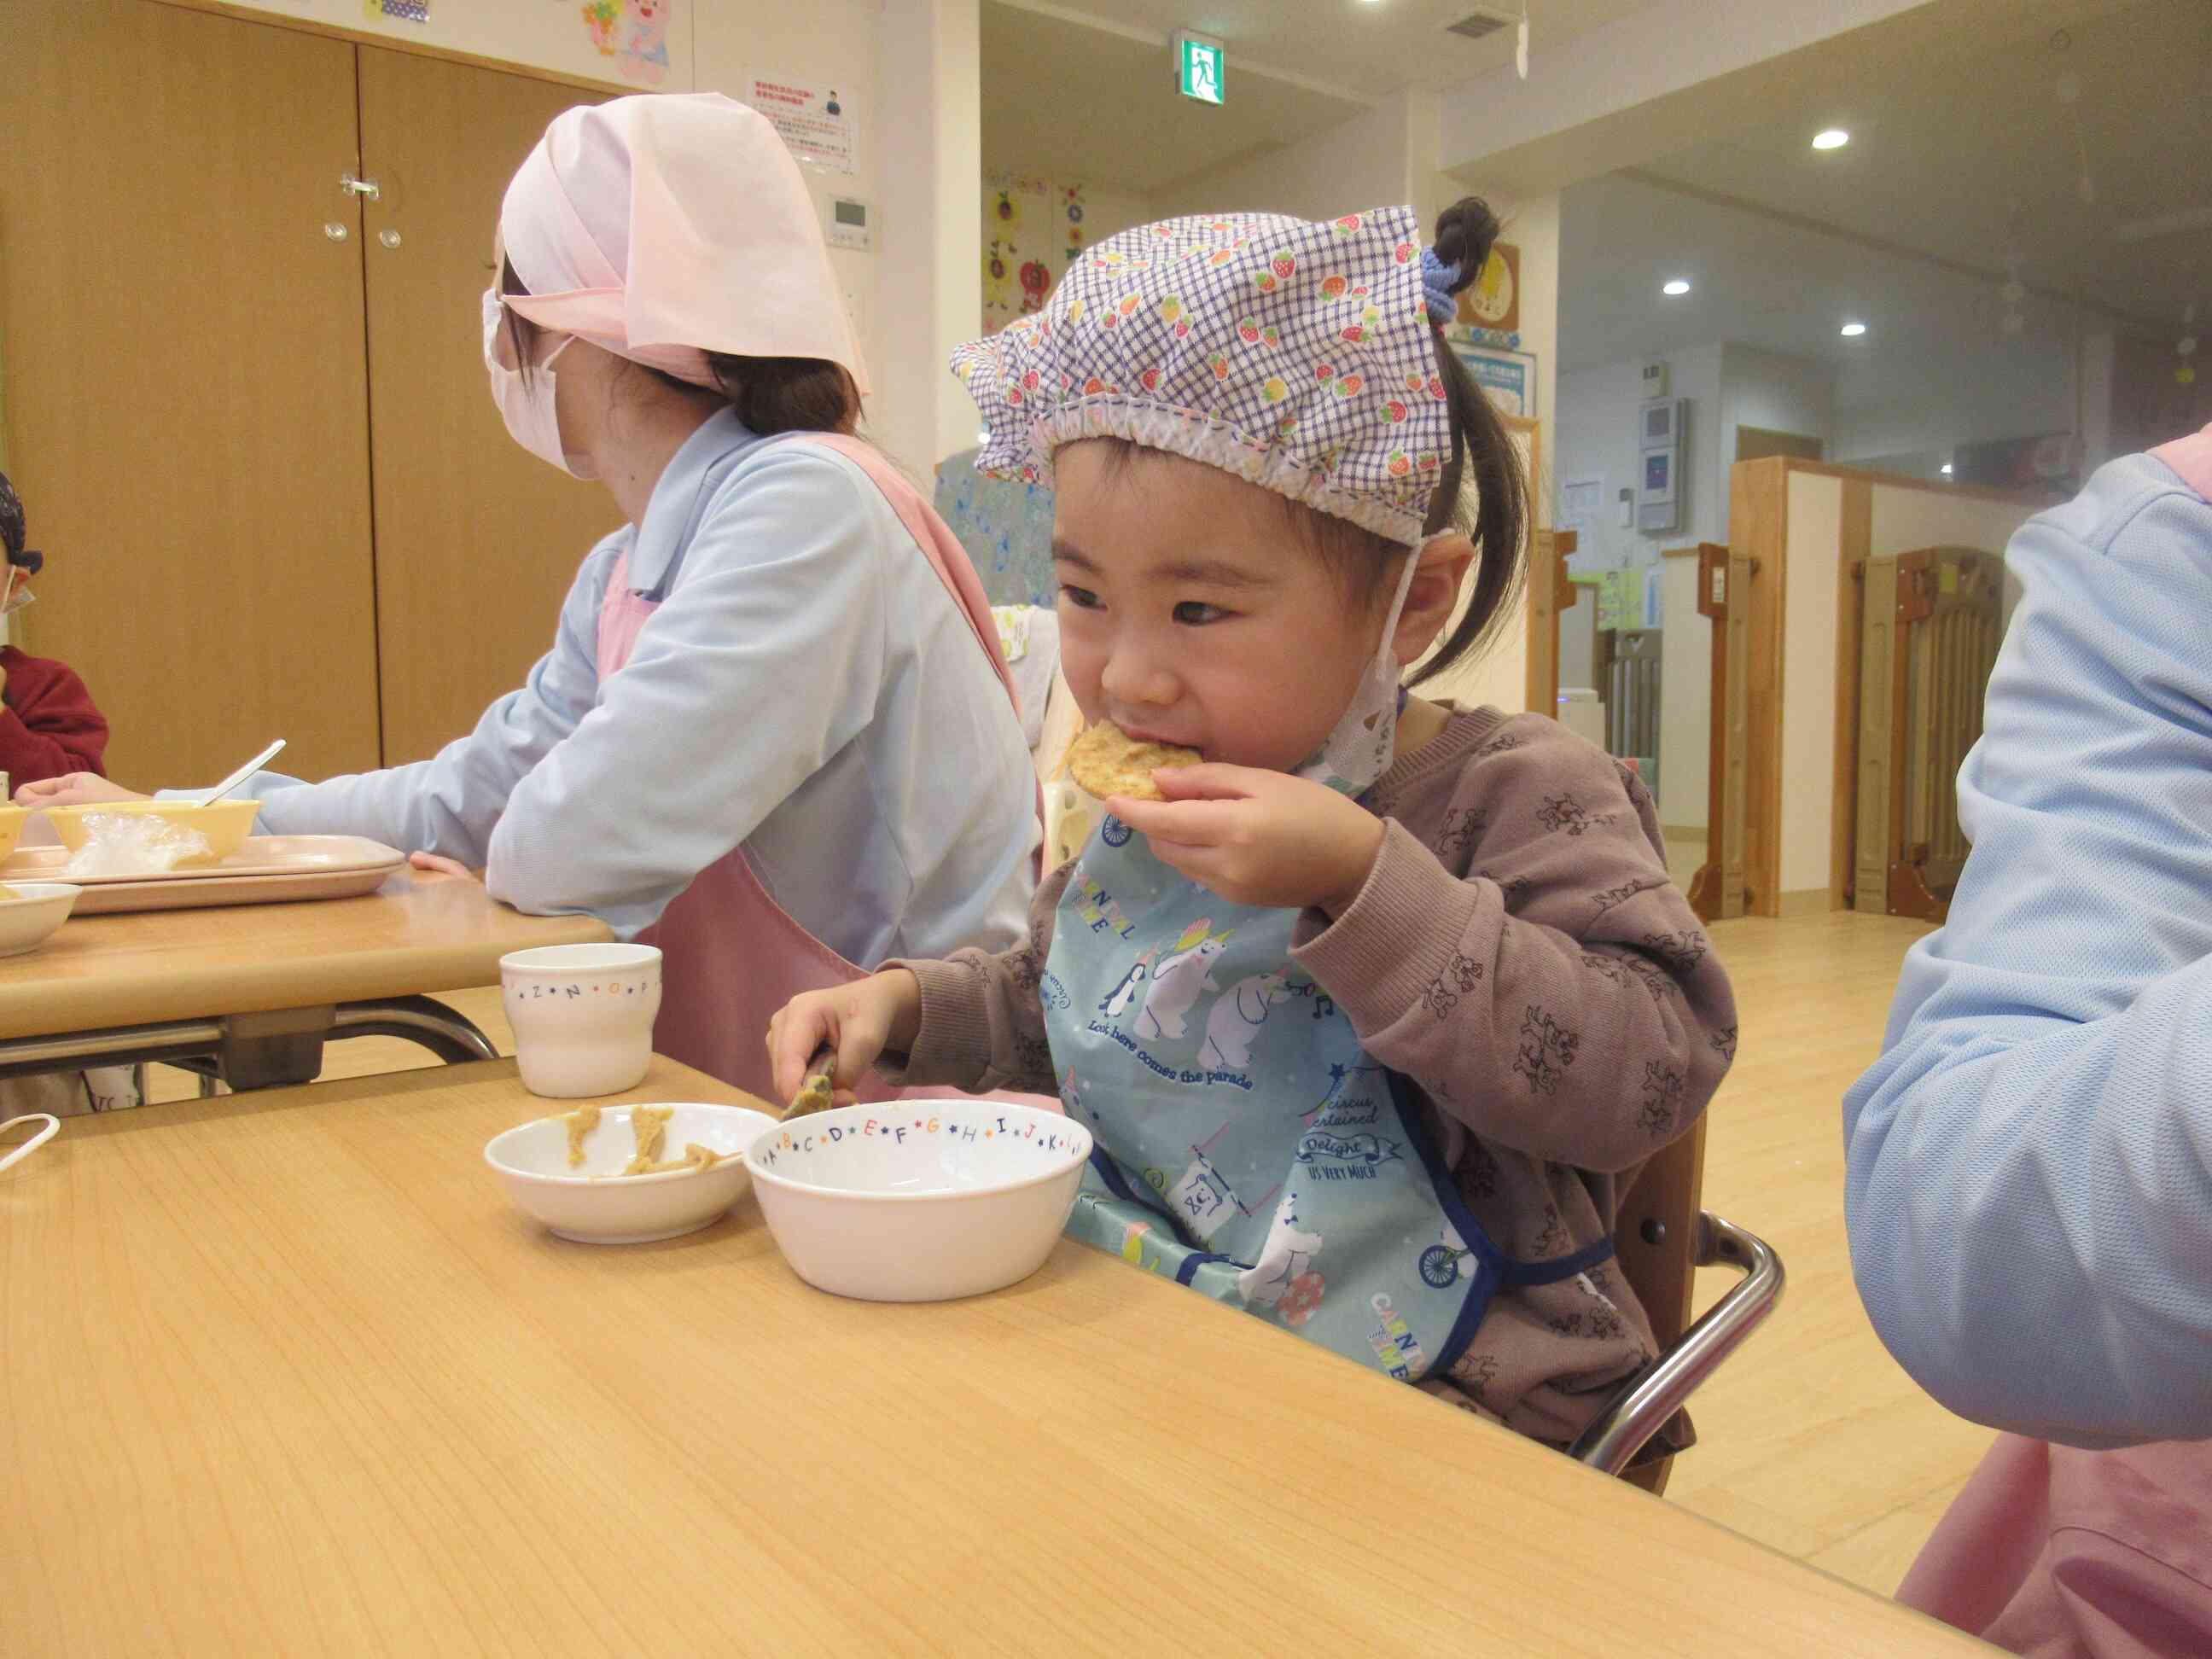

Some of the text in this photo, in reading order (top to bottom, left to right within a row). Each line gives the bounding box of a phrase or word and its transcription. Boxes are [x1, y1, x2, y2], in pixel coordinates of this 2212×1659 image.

[1110, 1026, 1138, 1052] here
[1138, 1051, 1177, 1080] comes
[1180, 1070, 1203, 1083] the
[1207, 1071, 1254, 1091] parade
[829, 1126, 843, 1142] D
[864, 1119, 877, 1136] E
[896, 1126, 907, 1144] F
[1306, 1138, 1361, 1159] Delight
[1322, 1165, 1347, 1180] VERY
[1347, 1163, 1377, 1180] MUCH
